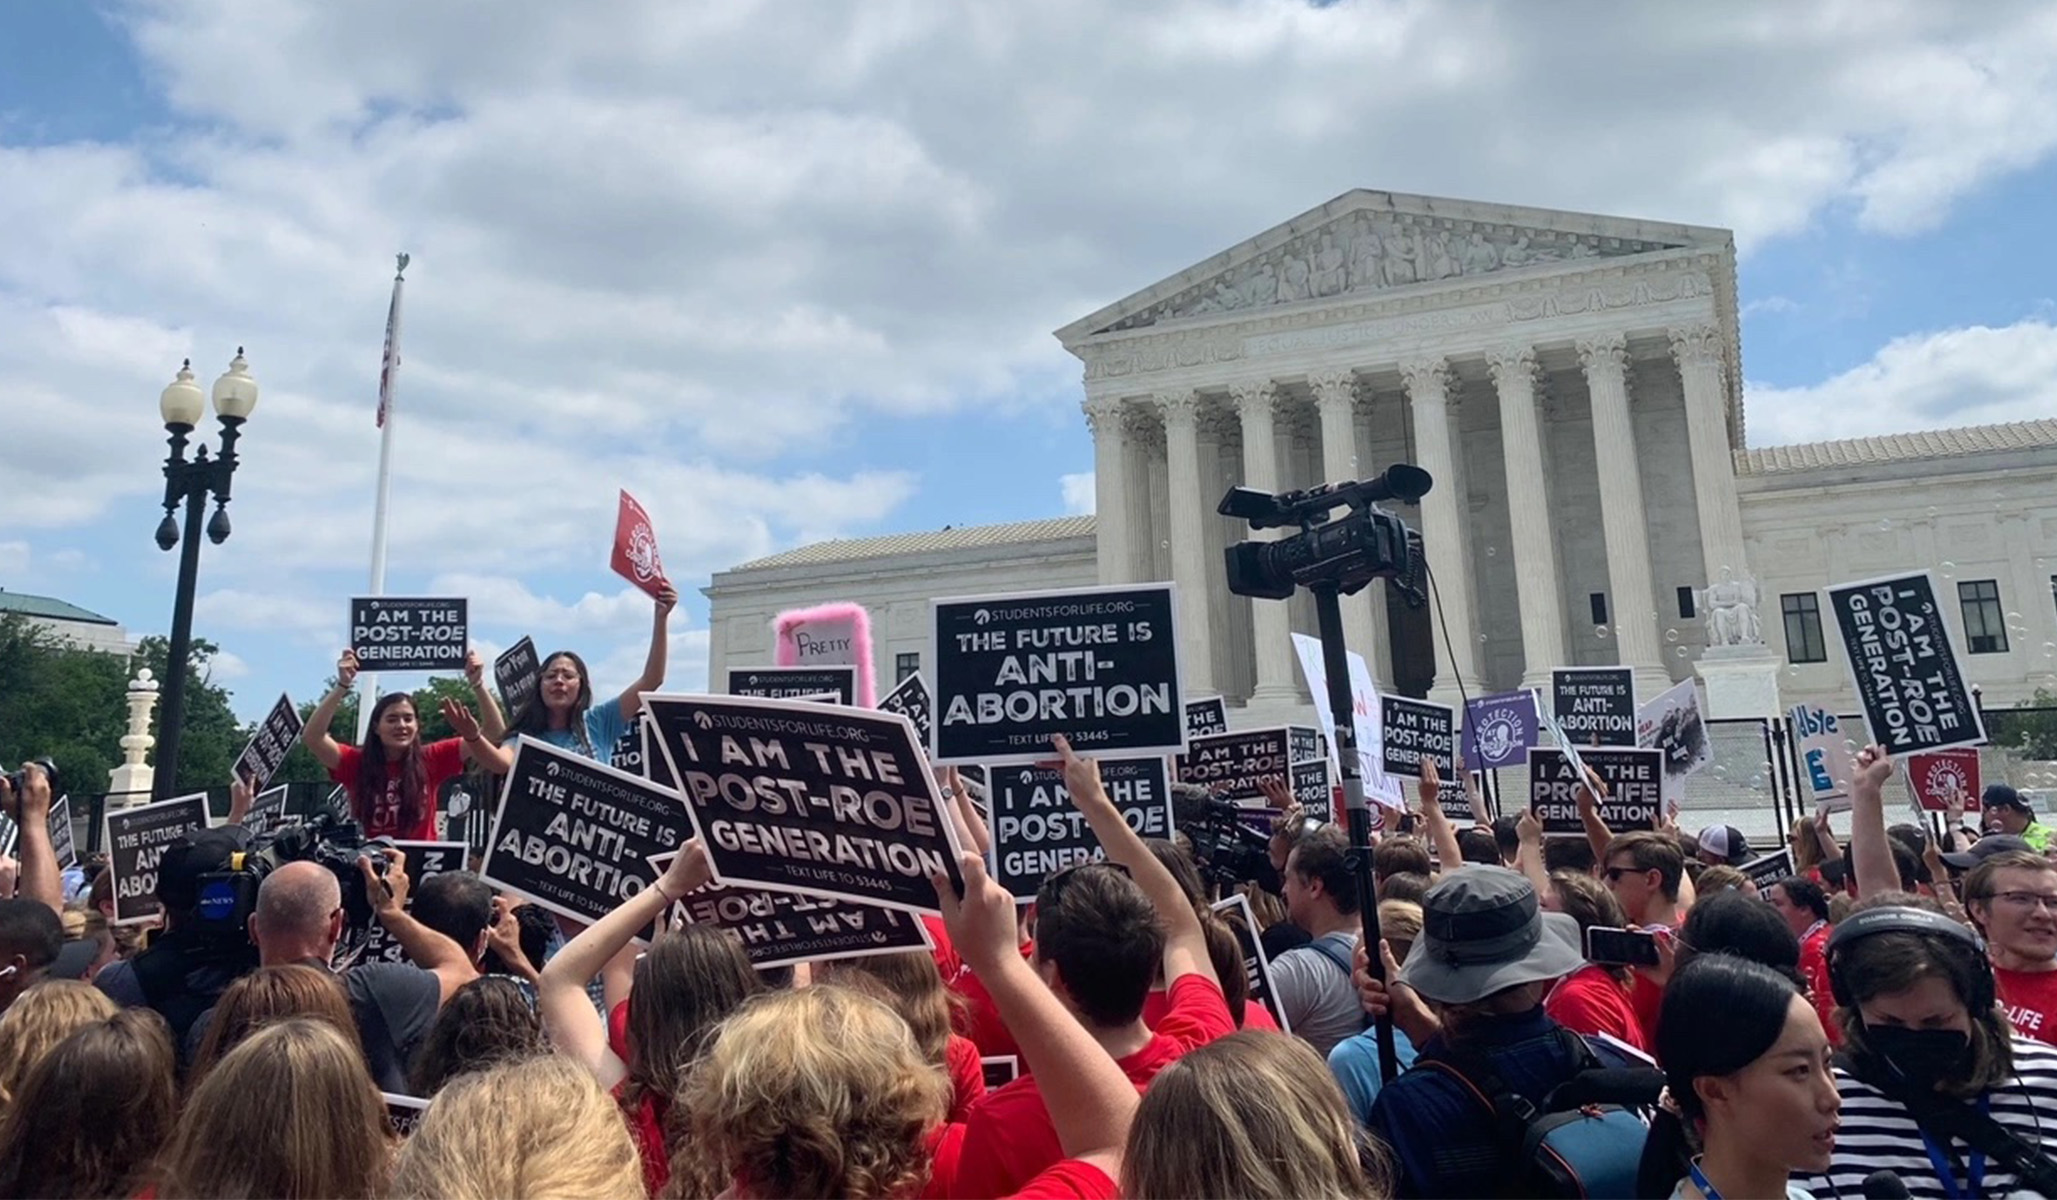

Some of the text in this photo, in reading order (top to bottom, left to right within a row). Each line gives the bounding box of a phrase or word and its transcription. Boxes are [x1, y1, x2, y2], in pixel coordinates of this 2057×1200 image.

[1898, 589, 1915, 598] I
[360, 610, 458, 622] I AM THE
[991, 601, 1135, 621] STUDENTSFORLIFE.ORG
[354, 625, 465, 642] POST-ROE
[956, 621, 1152, 652] THE FUTURE IS
[1906, 612, 1935, 658] AM
[356, 645, 463, 660] GENERATION
[1855, 655, 1866, 671] LIFE
[1871, 586, 1941, 743] POST-ROE
[995, 650, 1114, 686] ANTI-
[1849, 593, 1912, 745] GENERATION
[1559, 685, 1626, 695] THE FUTURE IS
[1926, 671, 1959, 730] THE
[942, 682, 1171, 726] ABORTION
[1573, 698, 1613, 712] ANTI-
[712, 716, 869, 743] STUDENTSFORLIFE.ORG
[1386, 710, 1391, 723] I
[1397, 713, 1417, 727] AM
[1422, 717, 1447, 732] THE
[1558, 715, 1633, 731] ABORTION
[1008, 734, 1032, 745] TEXT
[1034, 733, 1051, 744] LIF
[1076, 730, 1109, 742] 53445
[1384, 727, 1451, 751] POST-ROE
[681, 732, 699, 762] I
[721, 735, 790, 770] AM
[804, 742, 904, 785] THE
[1200, 746, 1230, 762] AM
[1239, 741, 1278, 756] THE
[1180, 754, 1286, 782] POST-ROE
[1300, 771, 1323, 785] THE
[1540, 765, 1545, 778] I
[1605, 765, 1649, 779] THE
[561, 767, 669, 816] STUDENTSFORLIFE.ORG
[685, 771, 936, 837] POST-ROE
[1005, 788, 1013, 809] I
[528, 776, 676, 847] THE FUTURE IS
[117, 833, 139, 849] THE
[142, 824, 184, 846] FUTURE
[544, 811, 638, 862] ANTI-
[711, 820, 948, 879] GENERATION
[497, 828, 645, 901] ABORTIO
[785, 864, 892, 891] TEXT LIFE TO 53445
[538, 880, 557, 894] TEXT
[558, 888, 575, 902] LIFE
[577, 894, 588, 907] TO
[807, 910, 864, 935] AM
[883, 909, 899, 926] I
[1994, 998, 2043, 1031] O-LIFE
